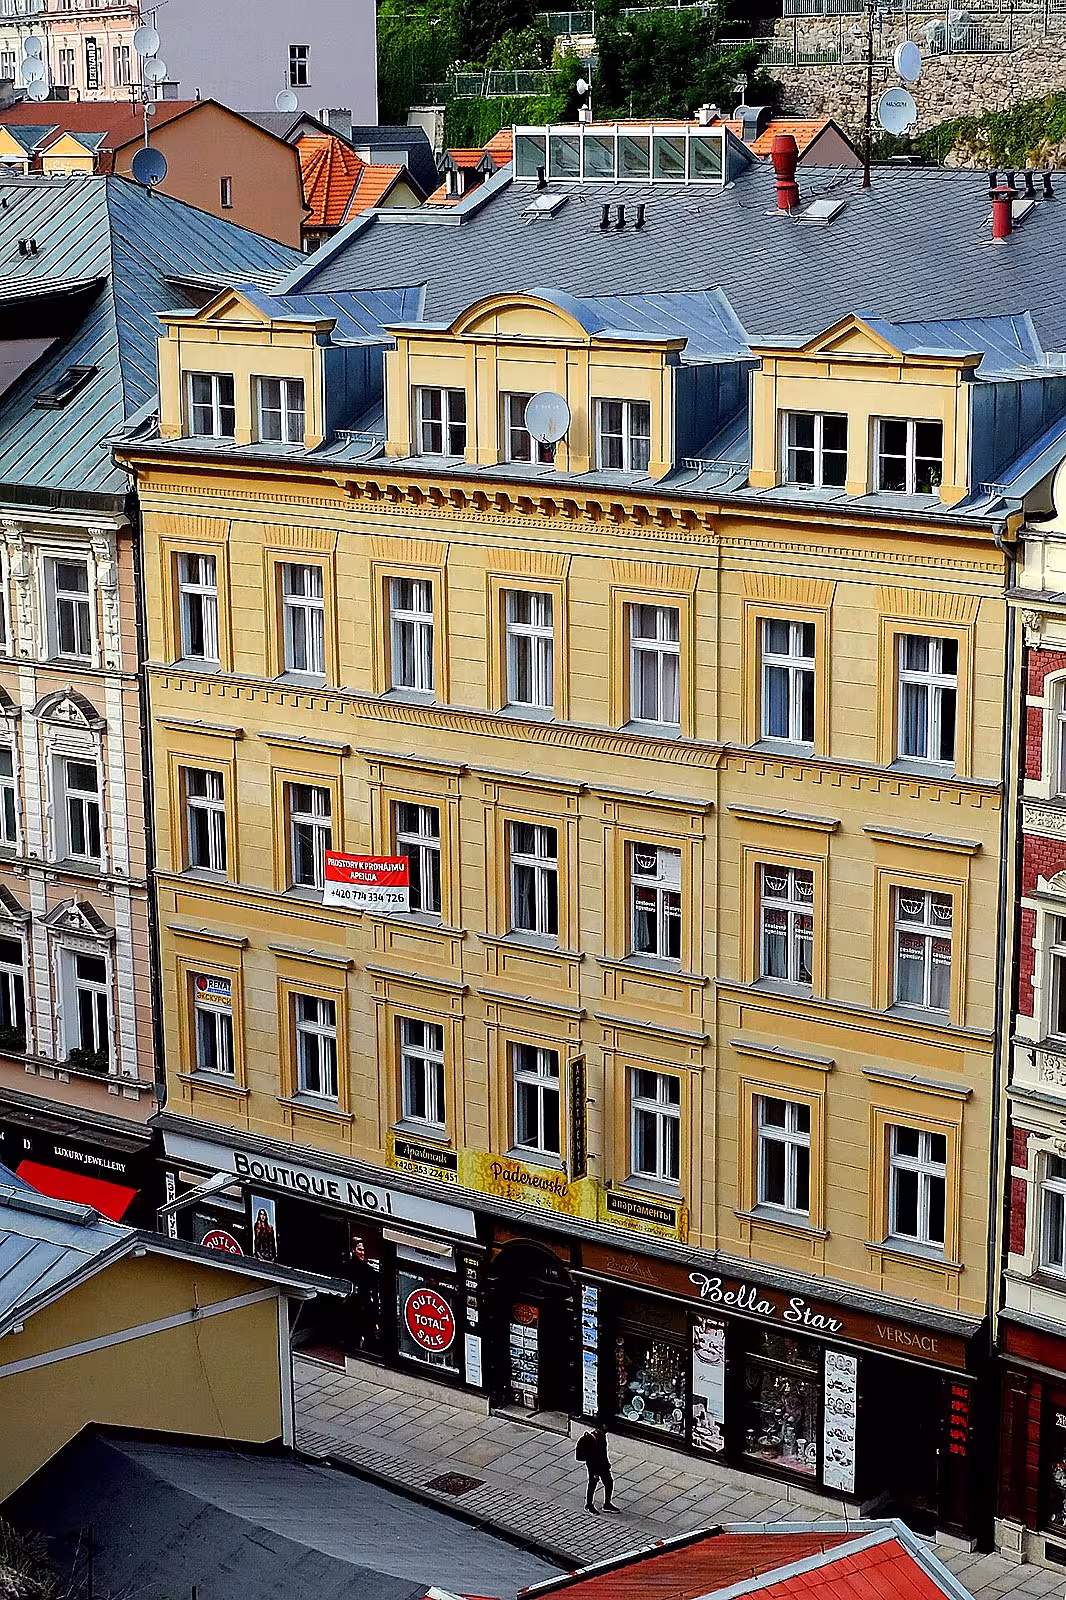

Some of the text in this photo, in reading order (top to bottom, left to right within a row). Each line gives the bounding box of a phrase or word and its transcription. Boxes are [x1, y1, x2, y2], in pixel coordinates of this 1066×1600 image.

[327, 857, 359, 869] PROSTORY
[359, 861, 365, 870] K
[331, 889, 405, 903] +420 774 334 726
[54, 1146, 126, 1172] LUXURY JEWELLERY
[403, 1144, 447, 1163] Apartments
[234, 1152, 341, 1200] BOUTIQUE
[394, 1161, 458, 1183] +420 353 224 451
[490, 1162, 568, 1198] Paderewski
[612, 1199, 671, 1221] апартаменты
[412, 1296, 450, 1322] OUTLET
[689, 1272, 843, 1332] Bella Star
[414, 1314, 446, 1330] TOTAL
[417, 1330, 444, 1346] SALE
[876, 1324, 939, 1353] VERSACE
[952, 1385, 968, 1398] SALE
